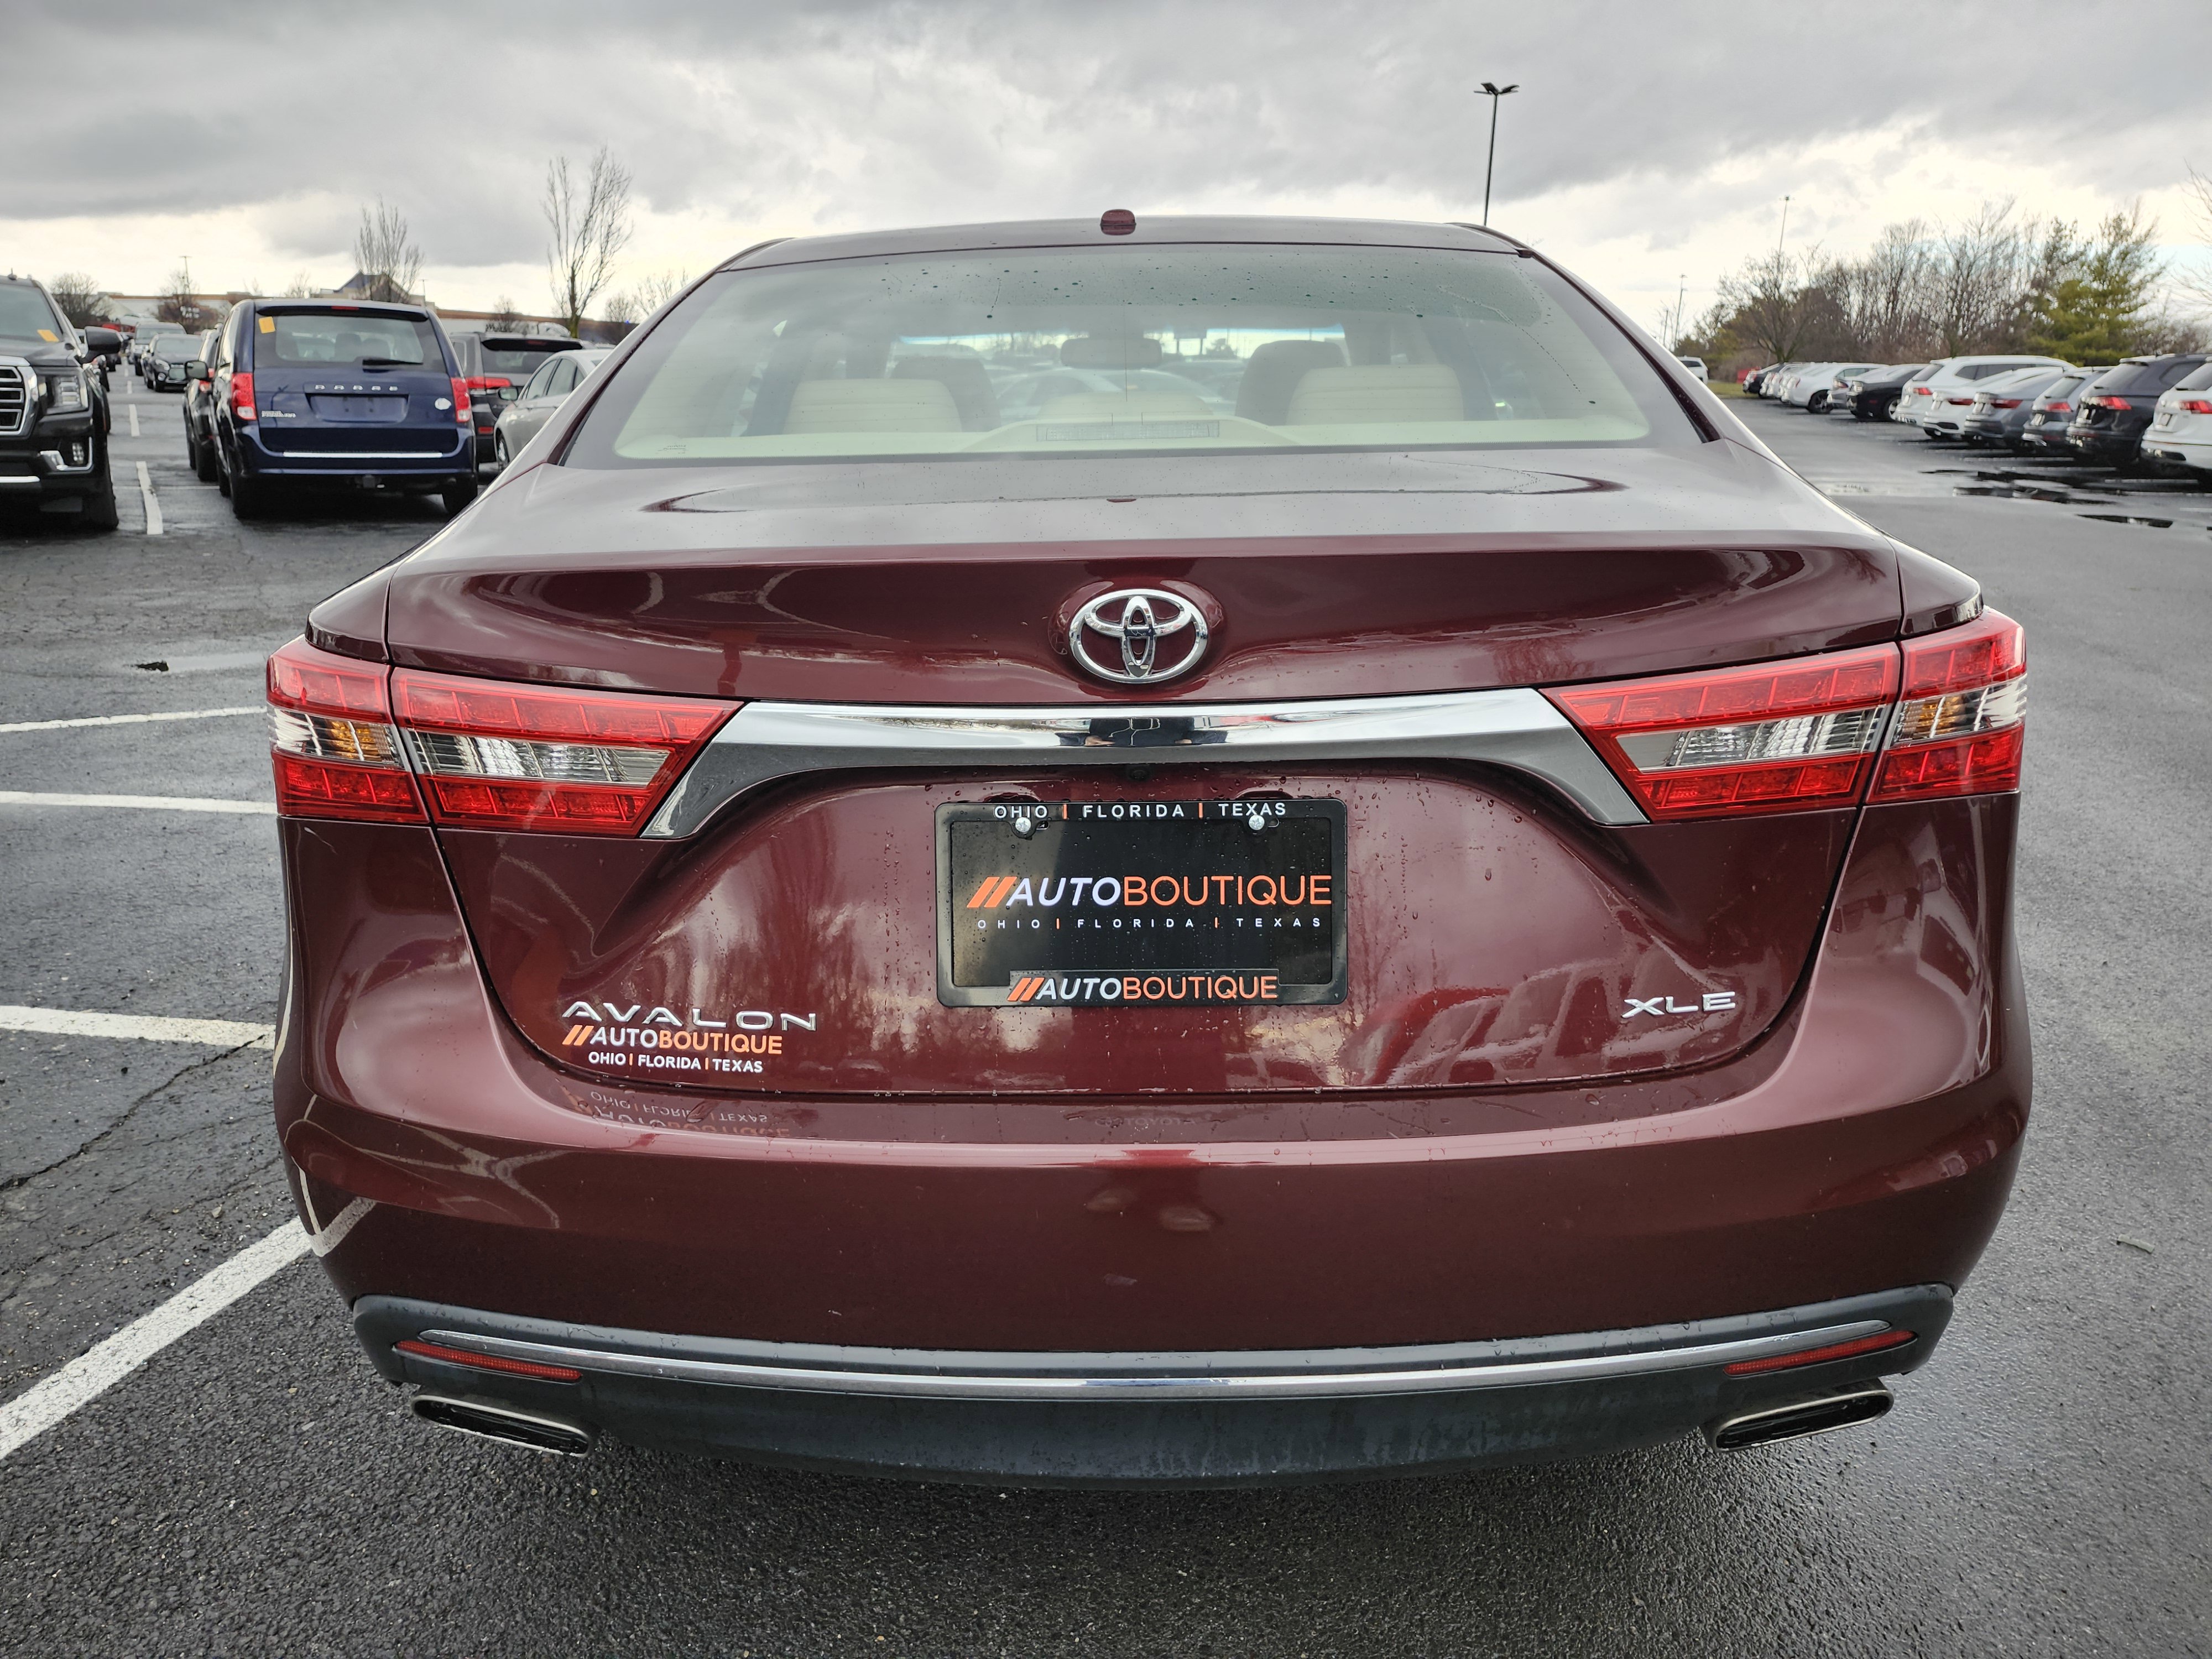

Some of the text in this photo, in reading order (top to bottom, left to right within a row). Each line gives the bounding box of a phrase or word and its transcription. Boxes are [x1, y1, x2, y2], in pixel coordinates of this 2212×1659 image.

[994, 802, 1286, 818] OHIO FLORIDA TEXAS
[977, 917, 1322, 929] OHIO FLORIDA TEXAS
[561, 1000, 817, 1032] AVALON
[1621, 991, 1736, 1019] XLE
[587, 1051, 764, 1074] OHIO FLORIDA TEXAS
